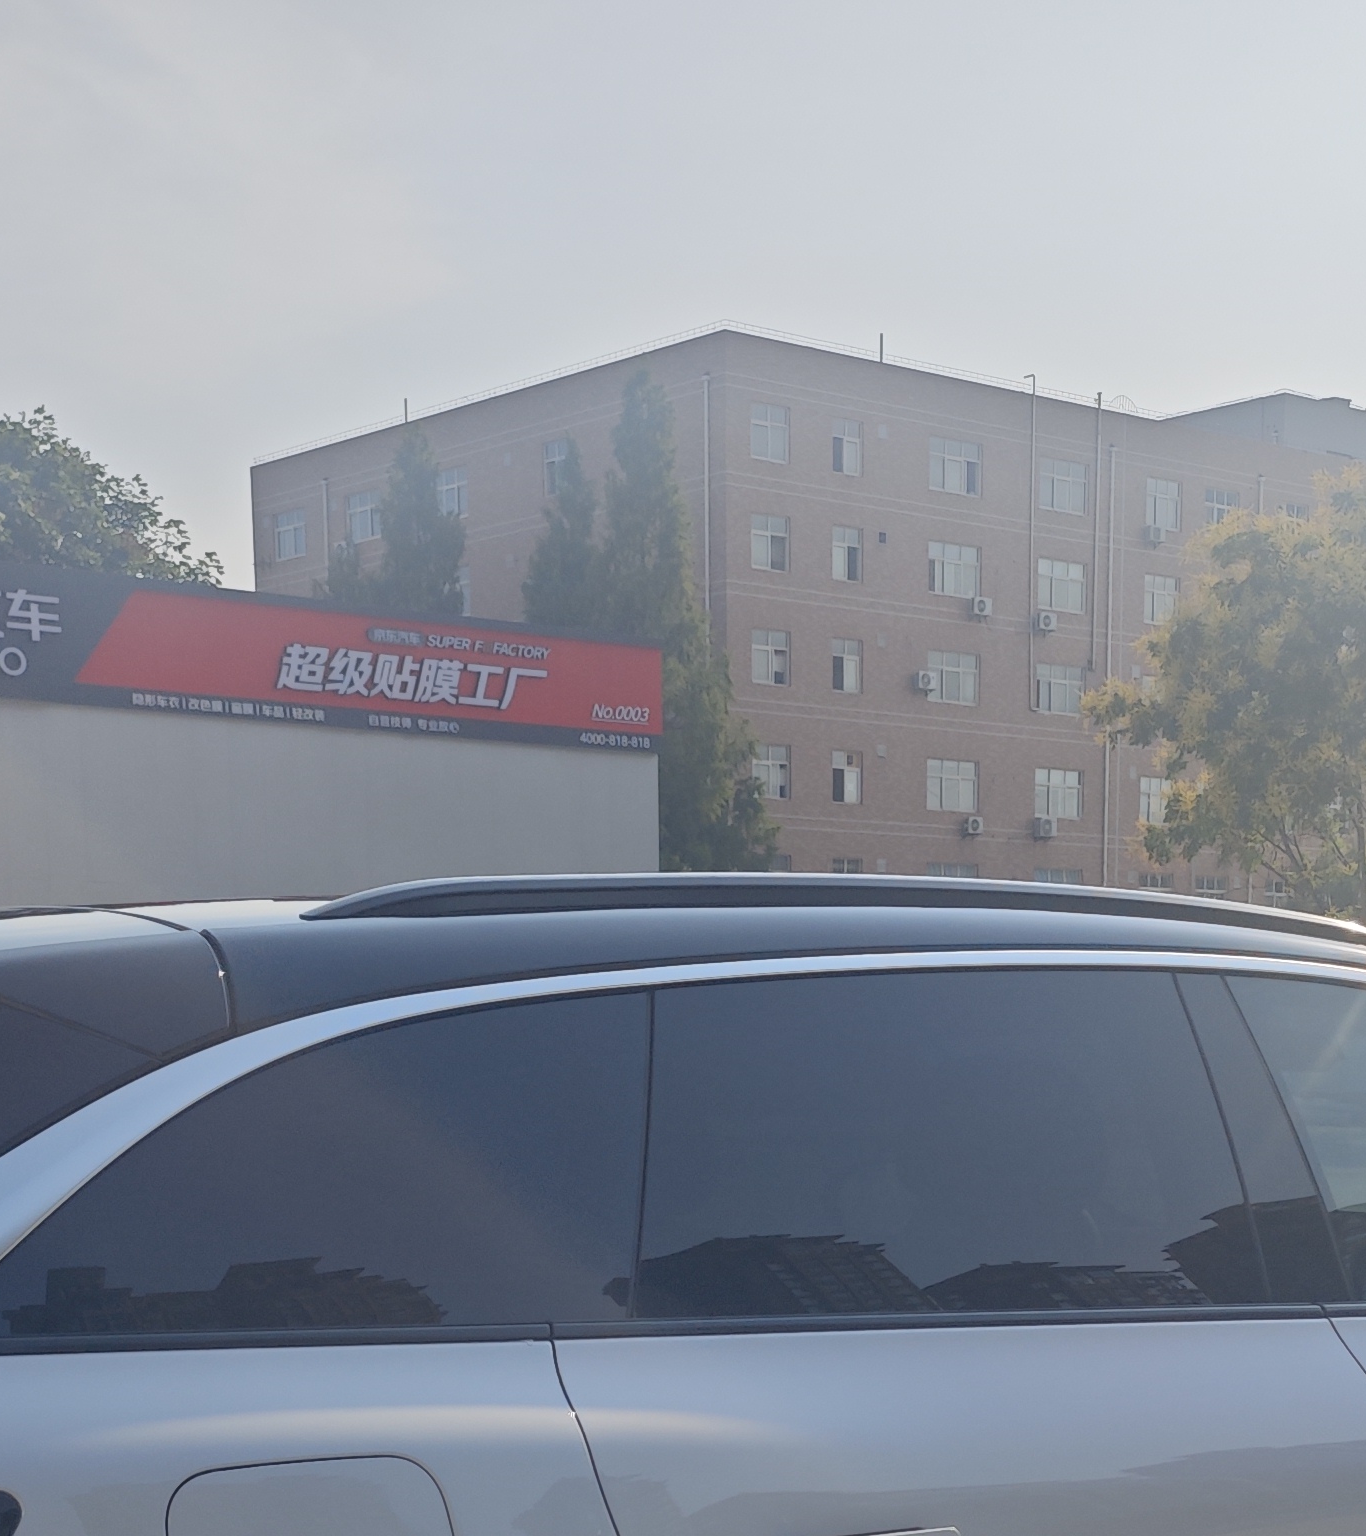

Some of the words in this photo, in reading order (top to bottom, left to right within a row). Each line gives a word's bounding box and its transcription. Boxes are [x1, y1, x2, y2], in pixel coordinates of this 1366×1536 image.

[373, 628, 421, 646] 京东汽车
[427, 634, 472, 650] SUPER
[492, 642, 551, 660] FACTORY
[276, 643, 548, 710] 超级贴膜工厂
[591, 703, 650, 722] No.0003
